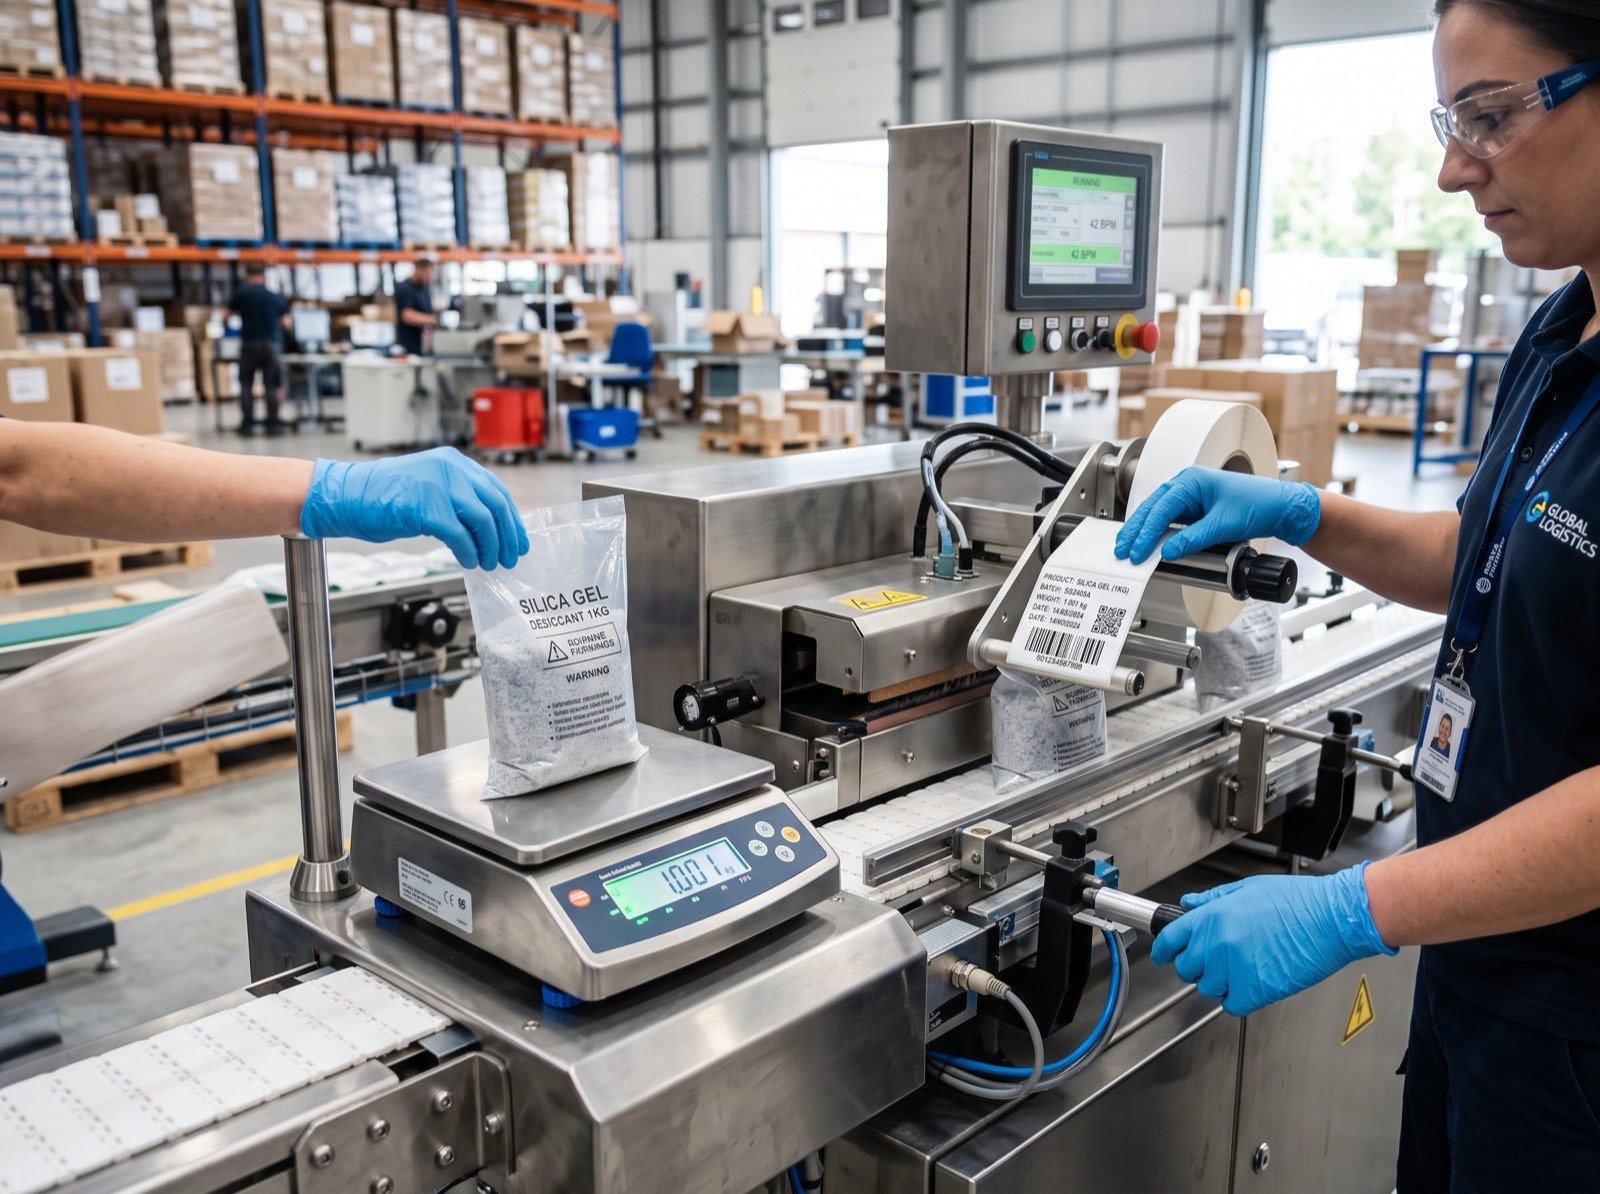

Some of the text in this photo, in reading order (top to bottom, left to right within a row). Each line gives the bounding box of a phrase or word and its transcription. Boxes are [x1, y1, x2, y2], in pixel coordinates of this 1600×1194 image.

[1073, 176, 1101, 187] RUNNING
[1090, 218, 1099, 229] 42
[1100, 219, 1117, 230] BPM
[1071, 249, 1097, 260] 42 BPM
[1547, 503, 1588, 537] GLOBAL
[1538, 515, 1598, 558] LOGISTICS
[1044, 572, 1130, 596] PRODUCT: SILICA GEL (1KG)
[519, 585, 609, 615] SILICA GEL
[1036, 593, 1061, 604] WEIGHT:
[1032, 603, 1050, 613] DATE:
[529, 605, 610, 630] DESICCANT 1KG
[1028, 613, 1047, 623] DATE:
[566, 665, 610, 683] WARNING
[661, 853, 722, 894] 1.001
